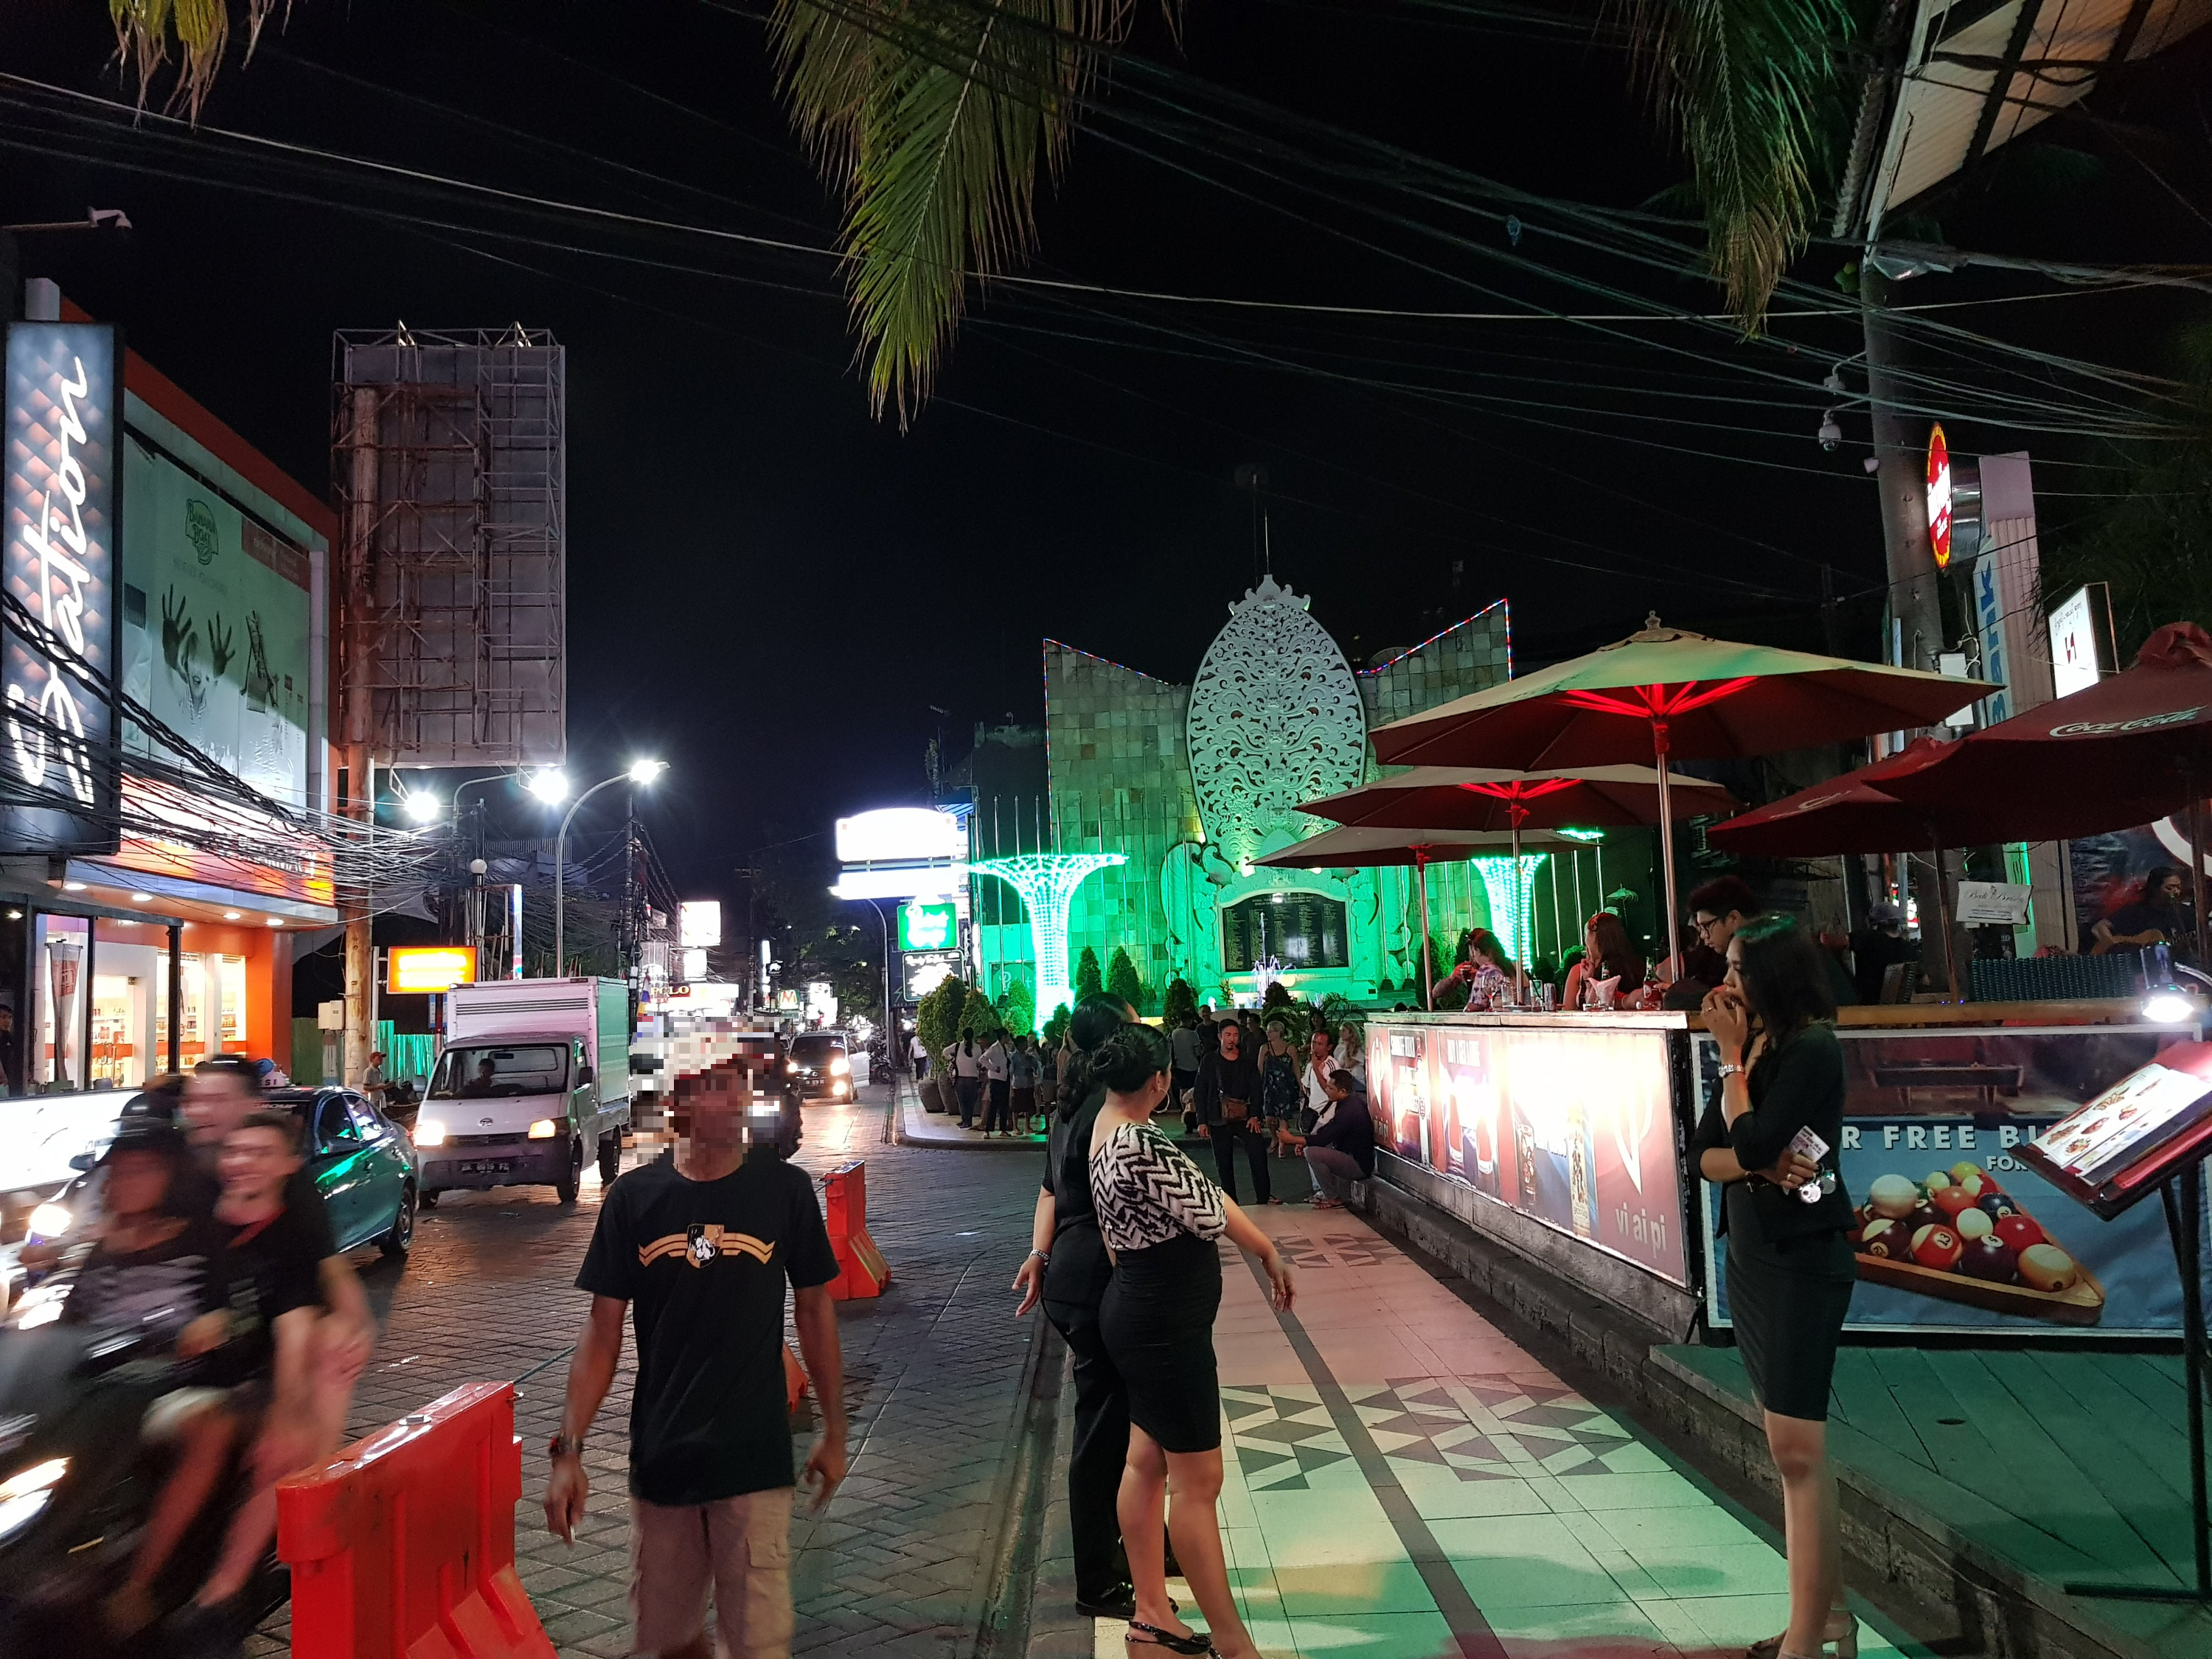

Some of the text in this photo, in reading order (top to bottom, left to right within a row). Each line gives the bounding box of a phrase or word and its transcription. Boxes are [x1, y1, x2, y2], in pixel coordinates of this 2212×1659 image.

[9, 355, 94, 810] Station
[1883, 1125, 1976, 1150] FREE
[1615, 1202, 1630, 1237] vi
[1632, 1208, 1648, 1245] ai
[1650, 1214, 1667, 1259] pi
[1937, 1233, 1951, 1247] 13
